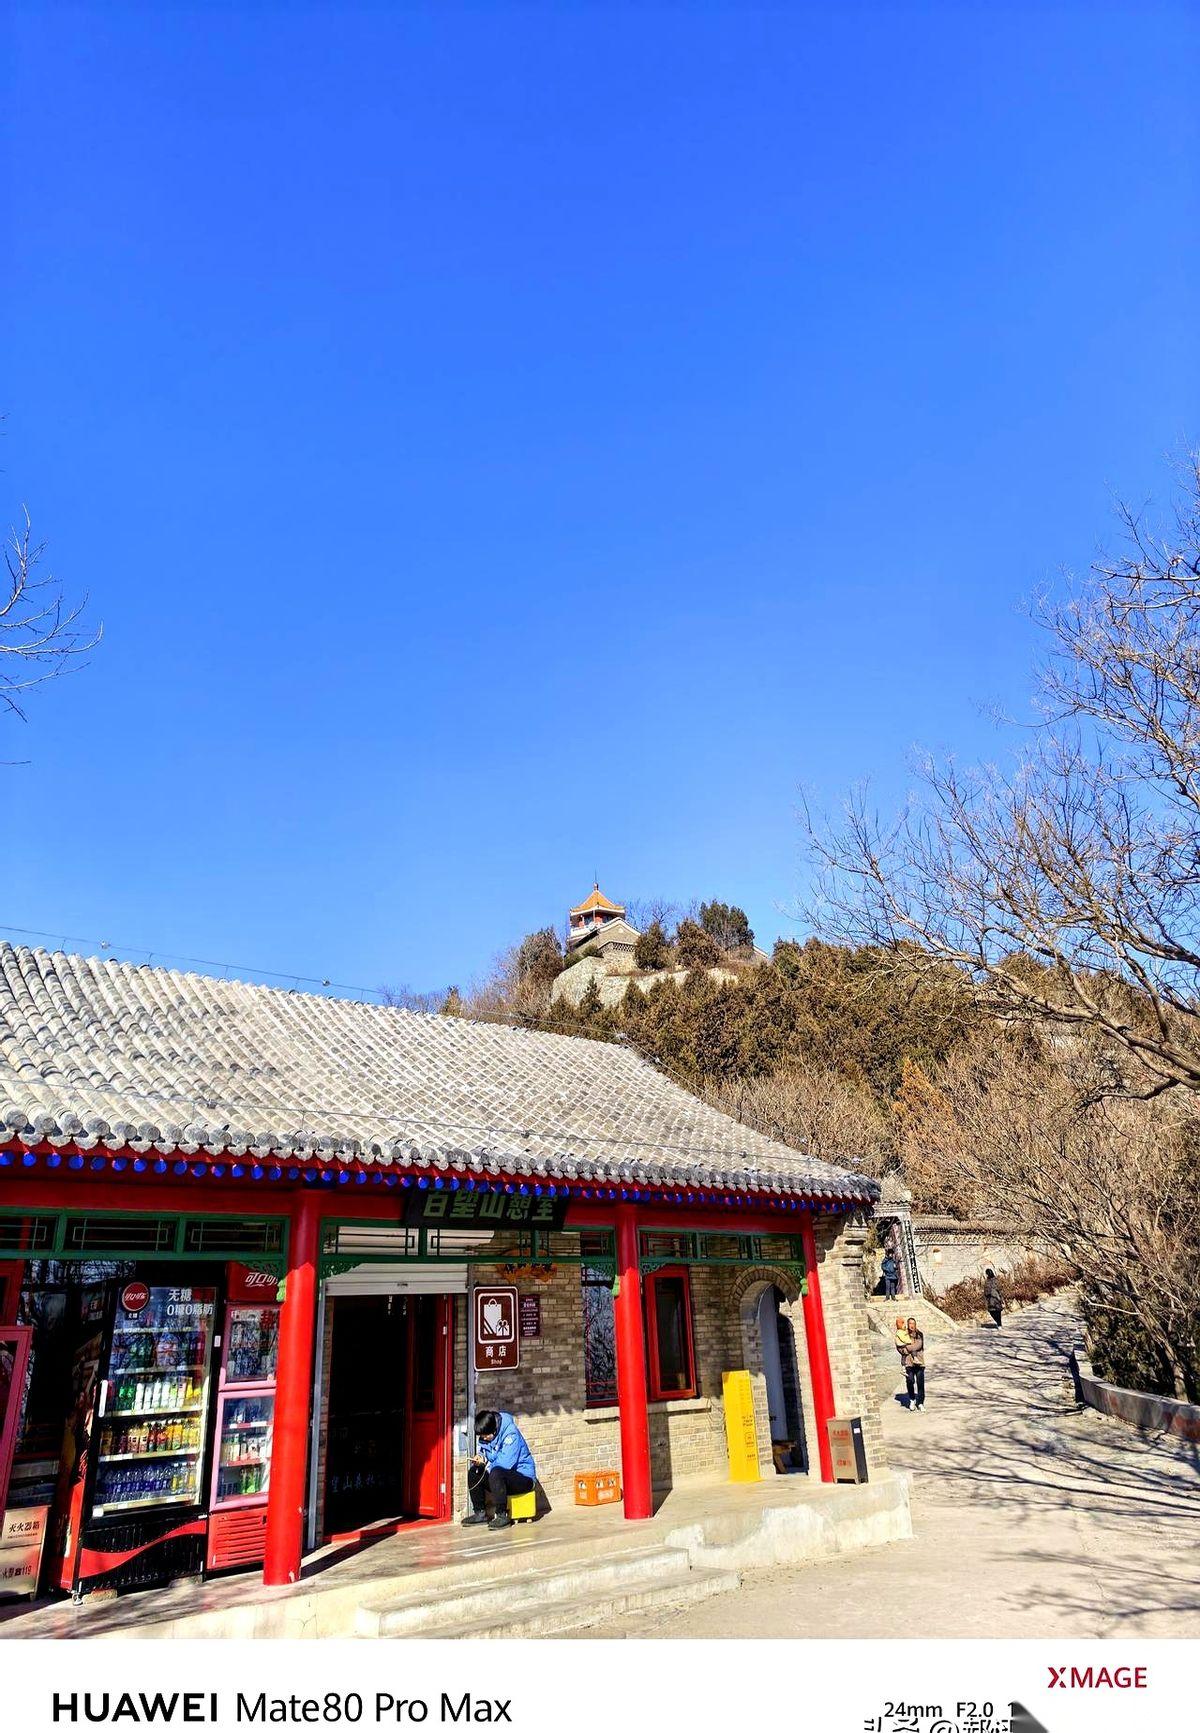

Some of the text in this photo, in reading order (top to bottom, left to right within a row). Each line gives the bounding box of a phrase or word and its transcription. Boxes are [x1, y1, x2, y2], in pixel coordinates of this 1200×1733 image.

[168, 1288, 193, 1302] 无糖
[485, 1345, 507, 1358] 商店
[9, 1521, 40, 1532] 灭火器箱
